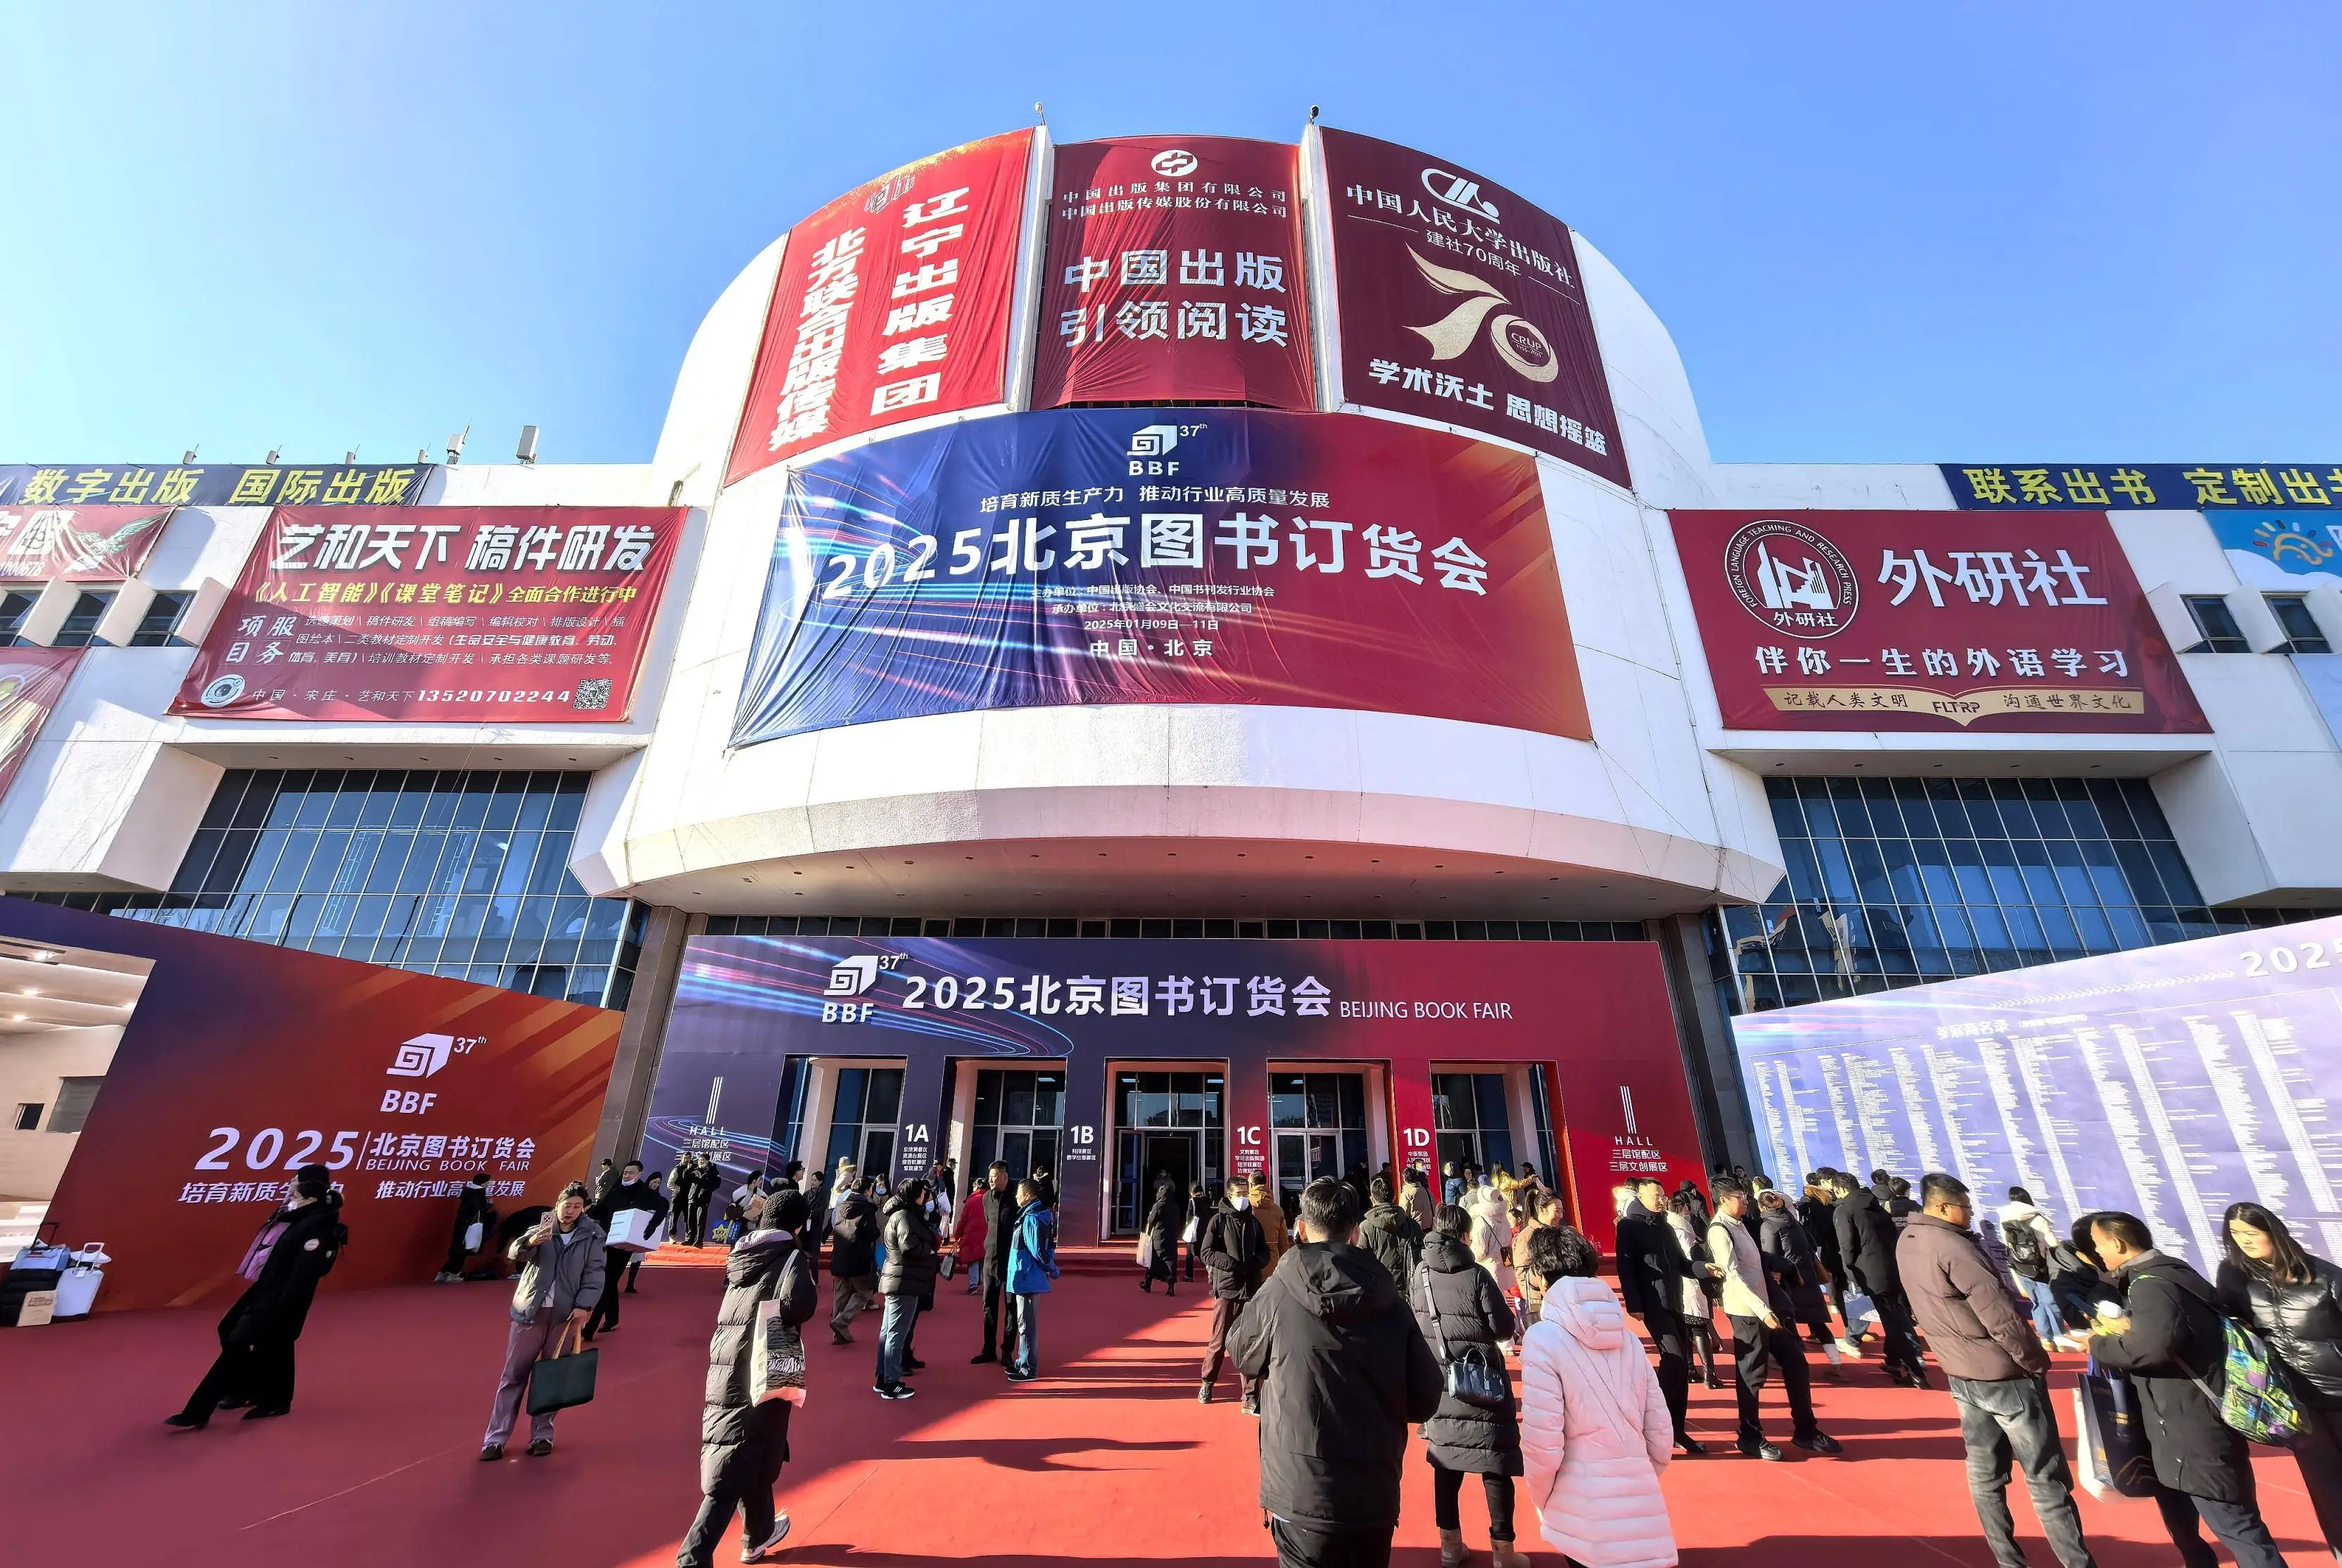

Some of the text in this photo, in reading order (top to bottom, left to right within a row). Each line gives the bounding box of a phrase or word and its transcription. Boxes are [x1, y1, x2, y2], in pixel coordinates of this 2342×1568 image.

[1063, 181, 1286, 203] 中国出版集团有限公司
[1062, 196, 1286, 220] 中国出版传媒股份有限公司
[1347, 184, 1575, 289] 中国人民大学出版社
[1426, 229, 1521, 277] 建社70周年
[1064, 248, 1286, 293] 中国出版
[871, 187, 970, 416] 辽宁出版集团
[1060, 300, 1288, 348] 引领阅读
[768, 226, 867, 451] 北方联合出版传媒
[1511, 332, 1542, 350] CRUP
[1369, 358, 1607, 456] 学术沃土 思想摇篮
[1179, 422, 1208, 437] 37th
[1129, 461, 1179, 476] BBF
[18, 468, 417, 505] 数字出版 国际出版
[1963, 467, 2158, 505] 联系出书
[980, 485, 1330, 514] 培育新质生产力 推动行业高质量发展
[272, 524, 655, 571] 艺和天下 稿件研发
[823, 512, 1488, 597] 2025北京图书订货会
[1730, 524, 1852, 607] FOREIGN LANGUAGE TEACHING AND RESEARCH PRESS
[1877, 549, 2108, 607] 外研社
[365, 615, 416, 626] 稿件研发
[488, 617, 538, 628] 编辑校对
[550, 617, 600, 628] 排版设计
[1773, 612, 1838, 626] 外研社
[296, 633, 334, 645] 图绘本
[368, 652, 474, 664] 培训教材定制开发
[1755, 645, 2128, 677] 伴你一生的外语学习
[417, 690, 569, 702] 13520702244
[1784, 692, 1909, 709] 记载人类文明
[2003, 693, 2132, 710] 沟通世界文化
[1932, 700, 1980, 714] FLTRP
[879, 952, 908, 970] 37th
[903, 975, 1331, 1016] 2025北京图书订货会
[821, 1003, 875, 1023] BBF
[1341, 1002, 1513, 1020] BEIJING BOOK FAIR
[453, 1035, 486, 1054] 37th
[380, 1089, 438, 1114] BBF
[690, 1126, 726, 1136] HALL
[906, 1124, 929, 1142] 1A
[1070, 1125, 1094, 1144] 1B
[1237, 1126, 1260, 1144] 1C
[1403, 1128, 1429, 1146] 1D
[194, 1127, 359, 1170] 2025
[369, 1132, 536, 1159] 北京图书订货会
[1615, 1136, 1652, 1146] HALL
[1612, 1149, 1661, 1159] 三层馆配区
[365, 1159, 529, 1171] BEIJING BOOK FAIR
[1609, 1161, 1668, 1171] 三层文创展区
[374, 1180, 526, 1199] 推动行业高量发展
